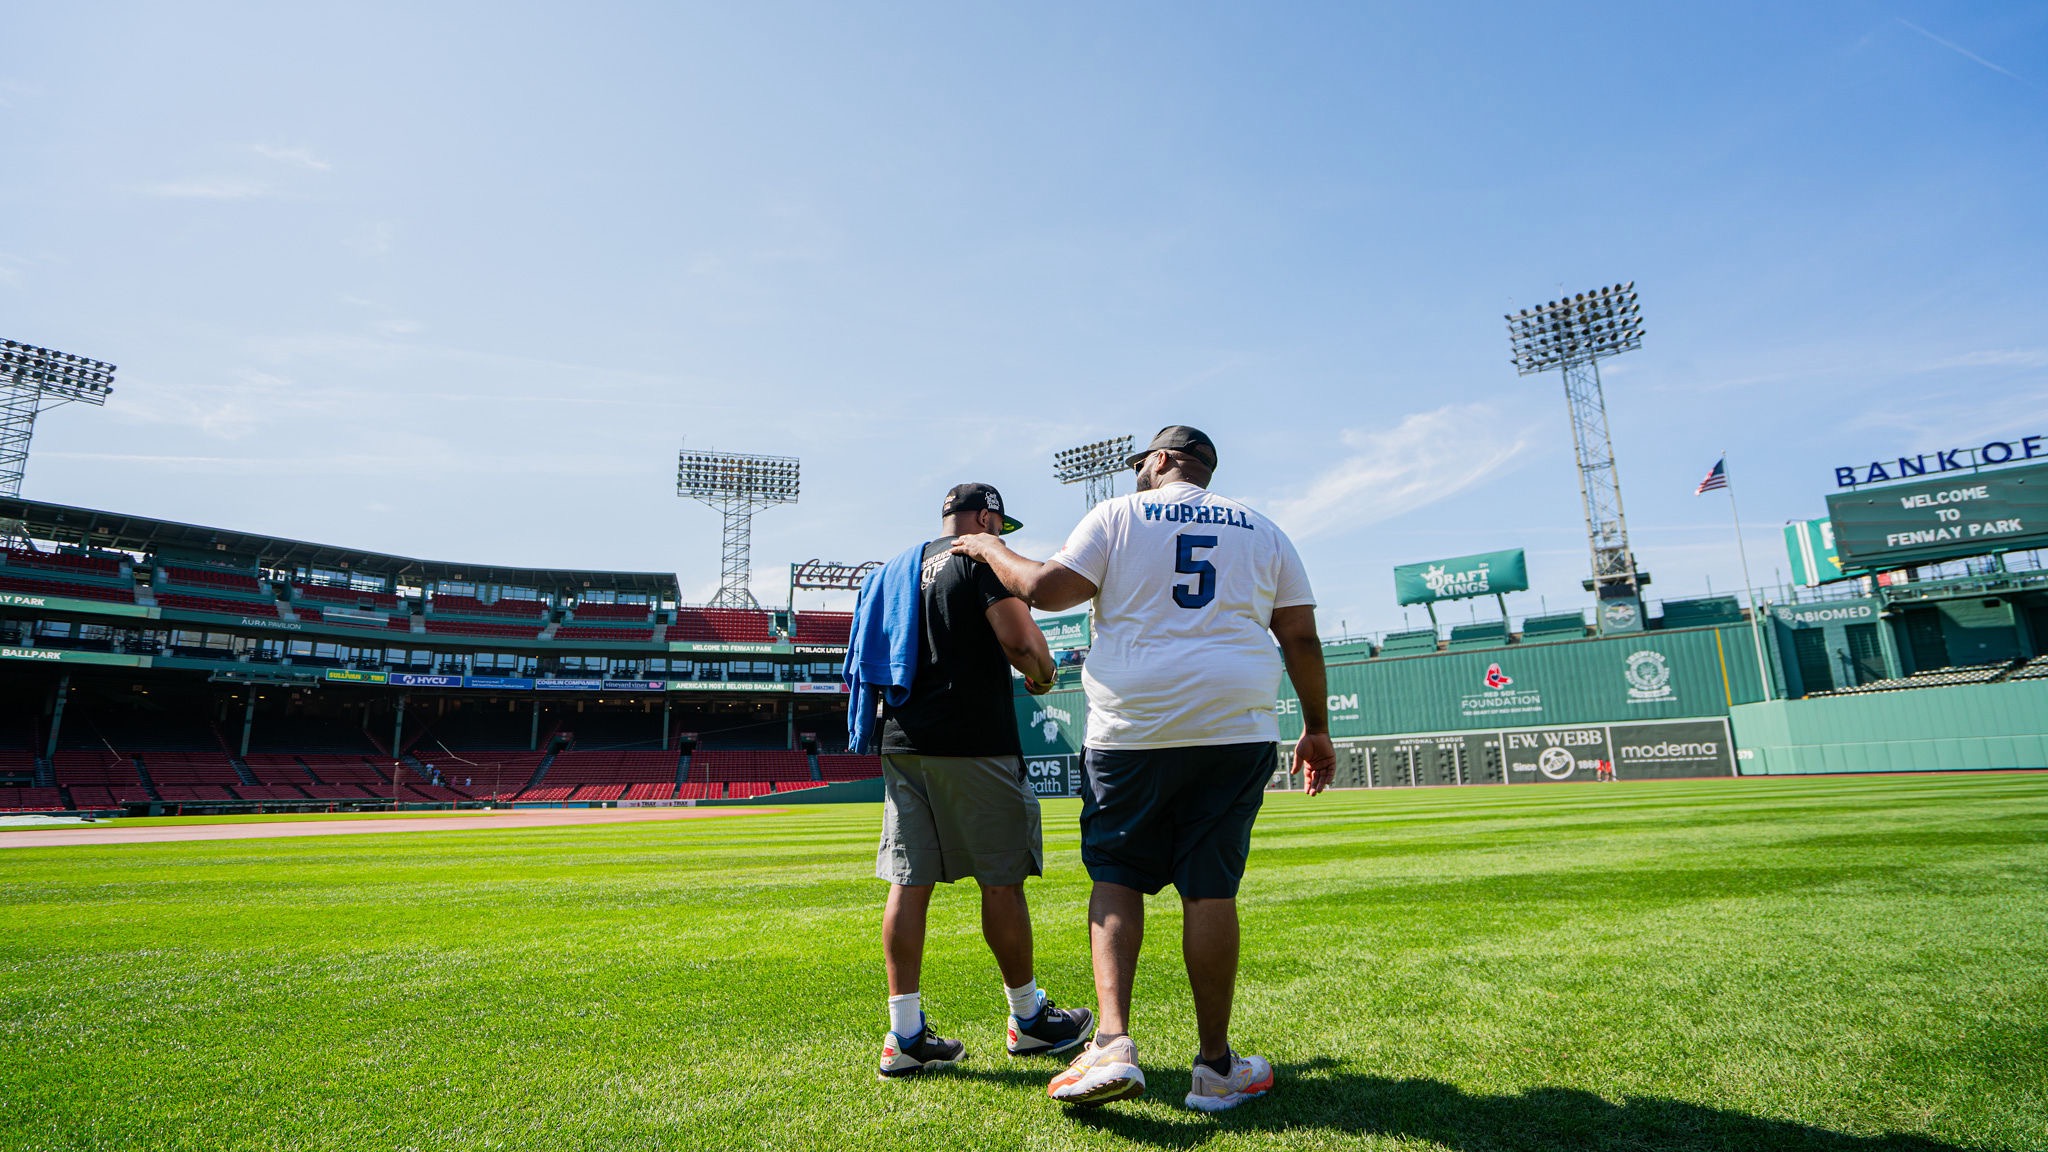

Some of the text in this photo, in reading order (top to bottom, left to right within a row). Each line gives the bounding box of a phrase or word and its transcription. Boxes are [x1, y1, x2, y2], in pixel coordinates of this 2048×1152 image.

[1835, 435, 2042, 488] BANK OF
[1901, 485, 1989, 509] WELCOME
[1143, 503, 1254, 530] WORRELL
[1935, 508, 1961, 522] TO
[1887, 518, 2024, 547] FENWAY PARK
[1172, 533, 1218, 609] 5
[1427, 569, 1490, 590] DRAFT
[1435, 580, 1490, 597] KINGS
[14, 597, 45, 606] PARK
[1795, 606, 1872, 623] ABIOMED
[268, 621, 302, 630] PAVILION
[1062, 622, 1082, 635] Rock
[2, 648, 61, 660] BALLPARK
[417, 676, 447, 685] HYCU
[1462, 695, 1541, 709] FOUNDATION
[1030, 705, 1071, 728] JIM BEAM
[1543, 730, 1603, 746] WEBB
[1621, 742, 1718, 758] moderna
[1028, 760, 1061, 777] CVS
[1512, 762, 1537, 771] Since
